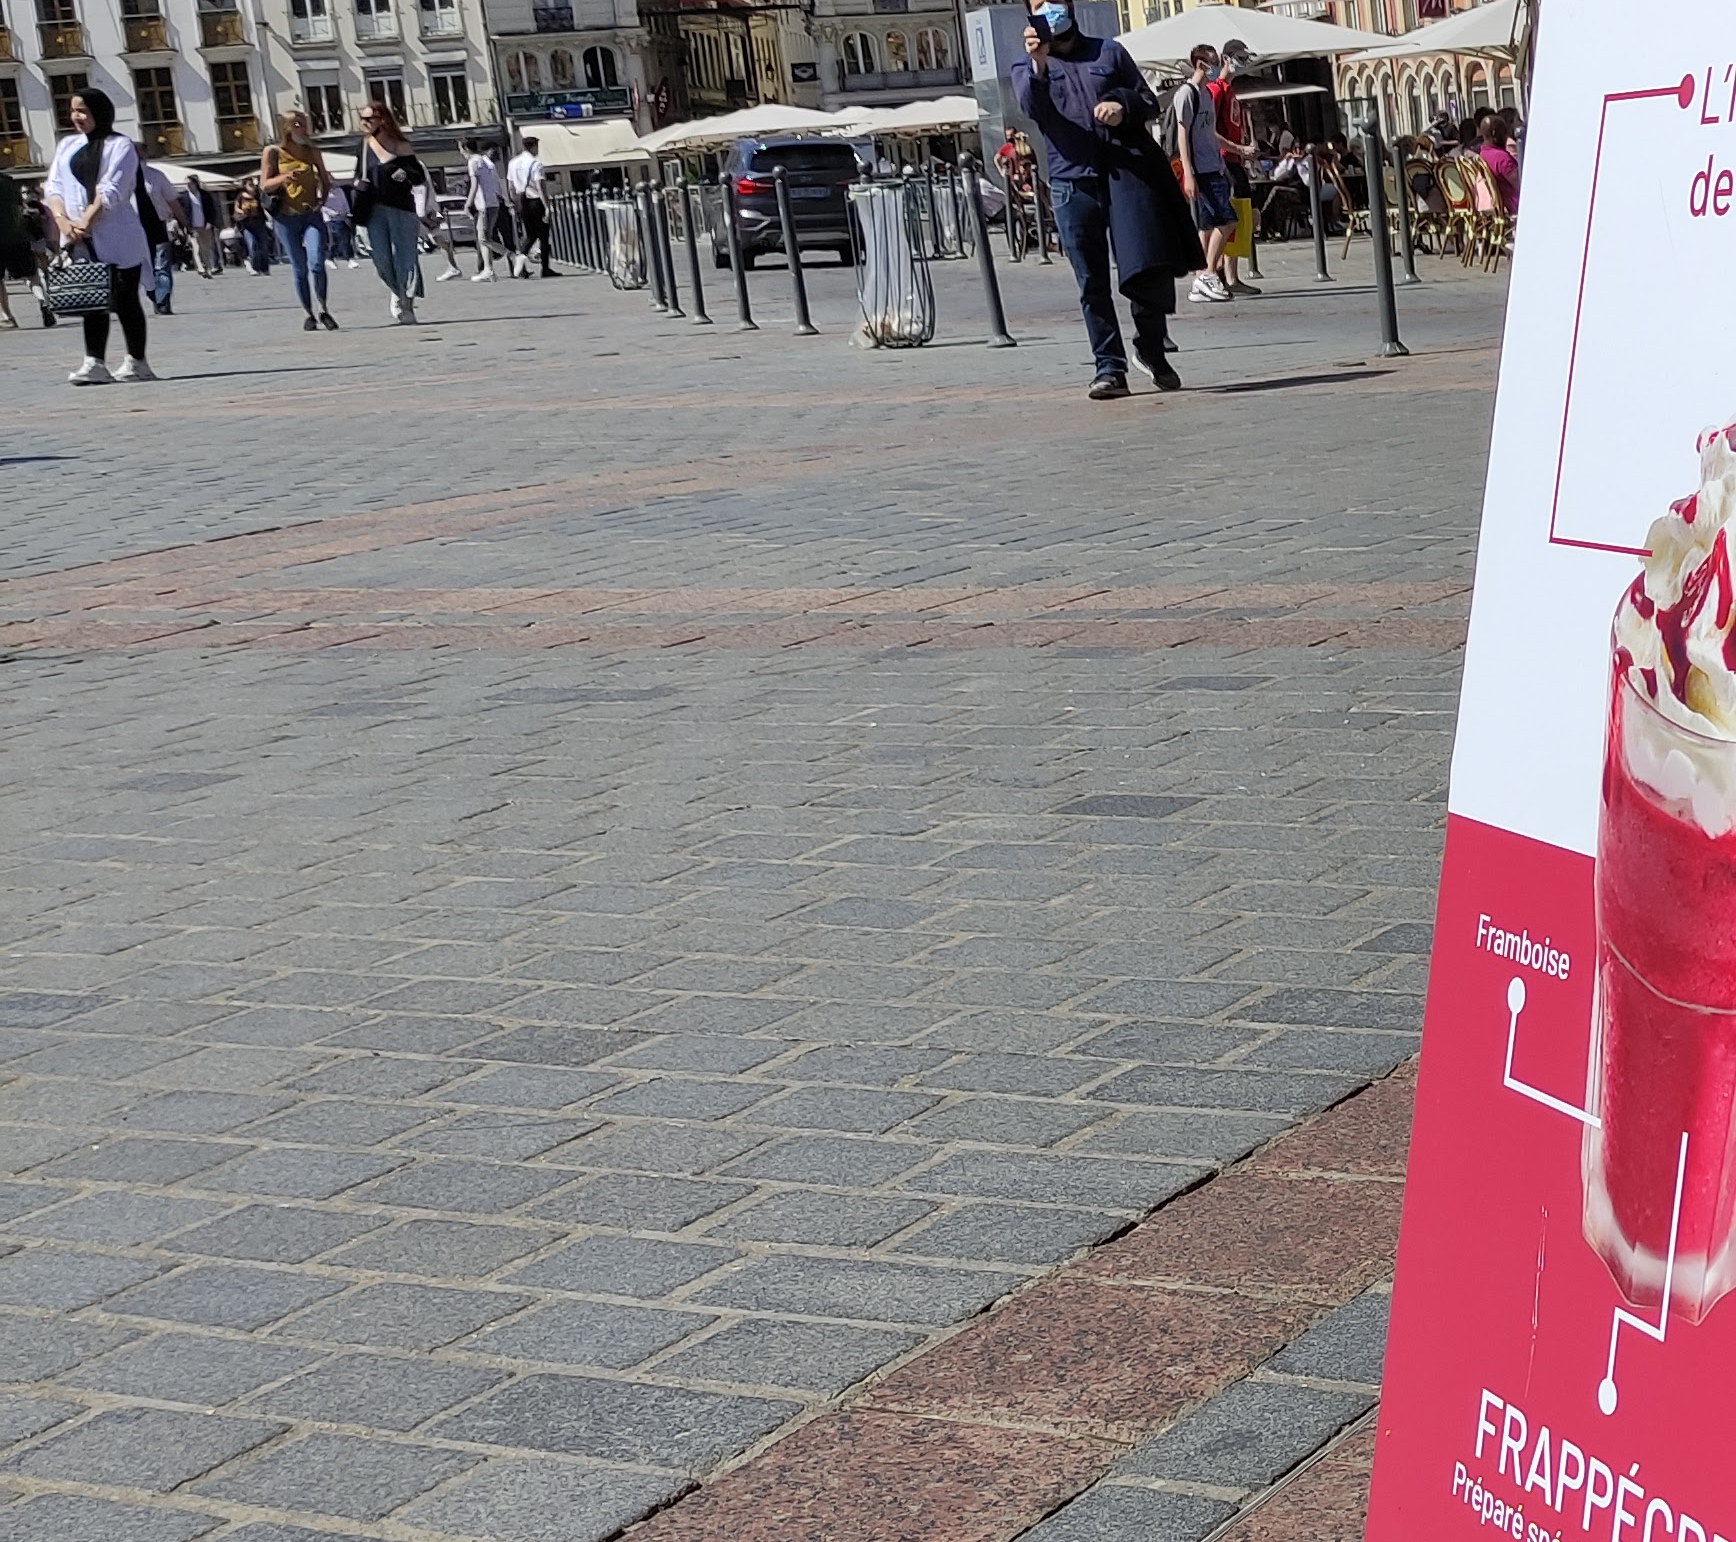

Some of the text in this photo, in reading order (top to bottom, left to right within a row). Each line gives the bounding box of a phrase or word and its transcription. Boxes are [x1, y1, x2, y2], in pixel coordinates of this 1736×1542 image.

[1689, 154, 1734, 217] de
[1475, 913, 1571, 980] Framboise
[1452, 1460, 1525, 1541] Préparé
